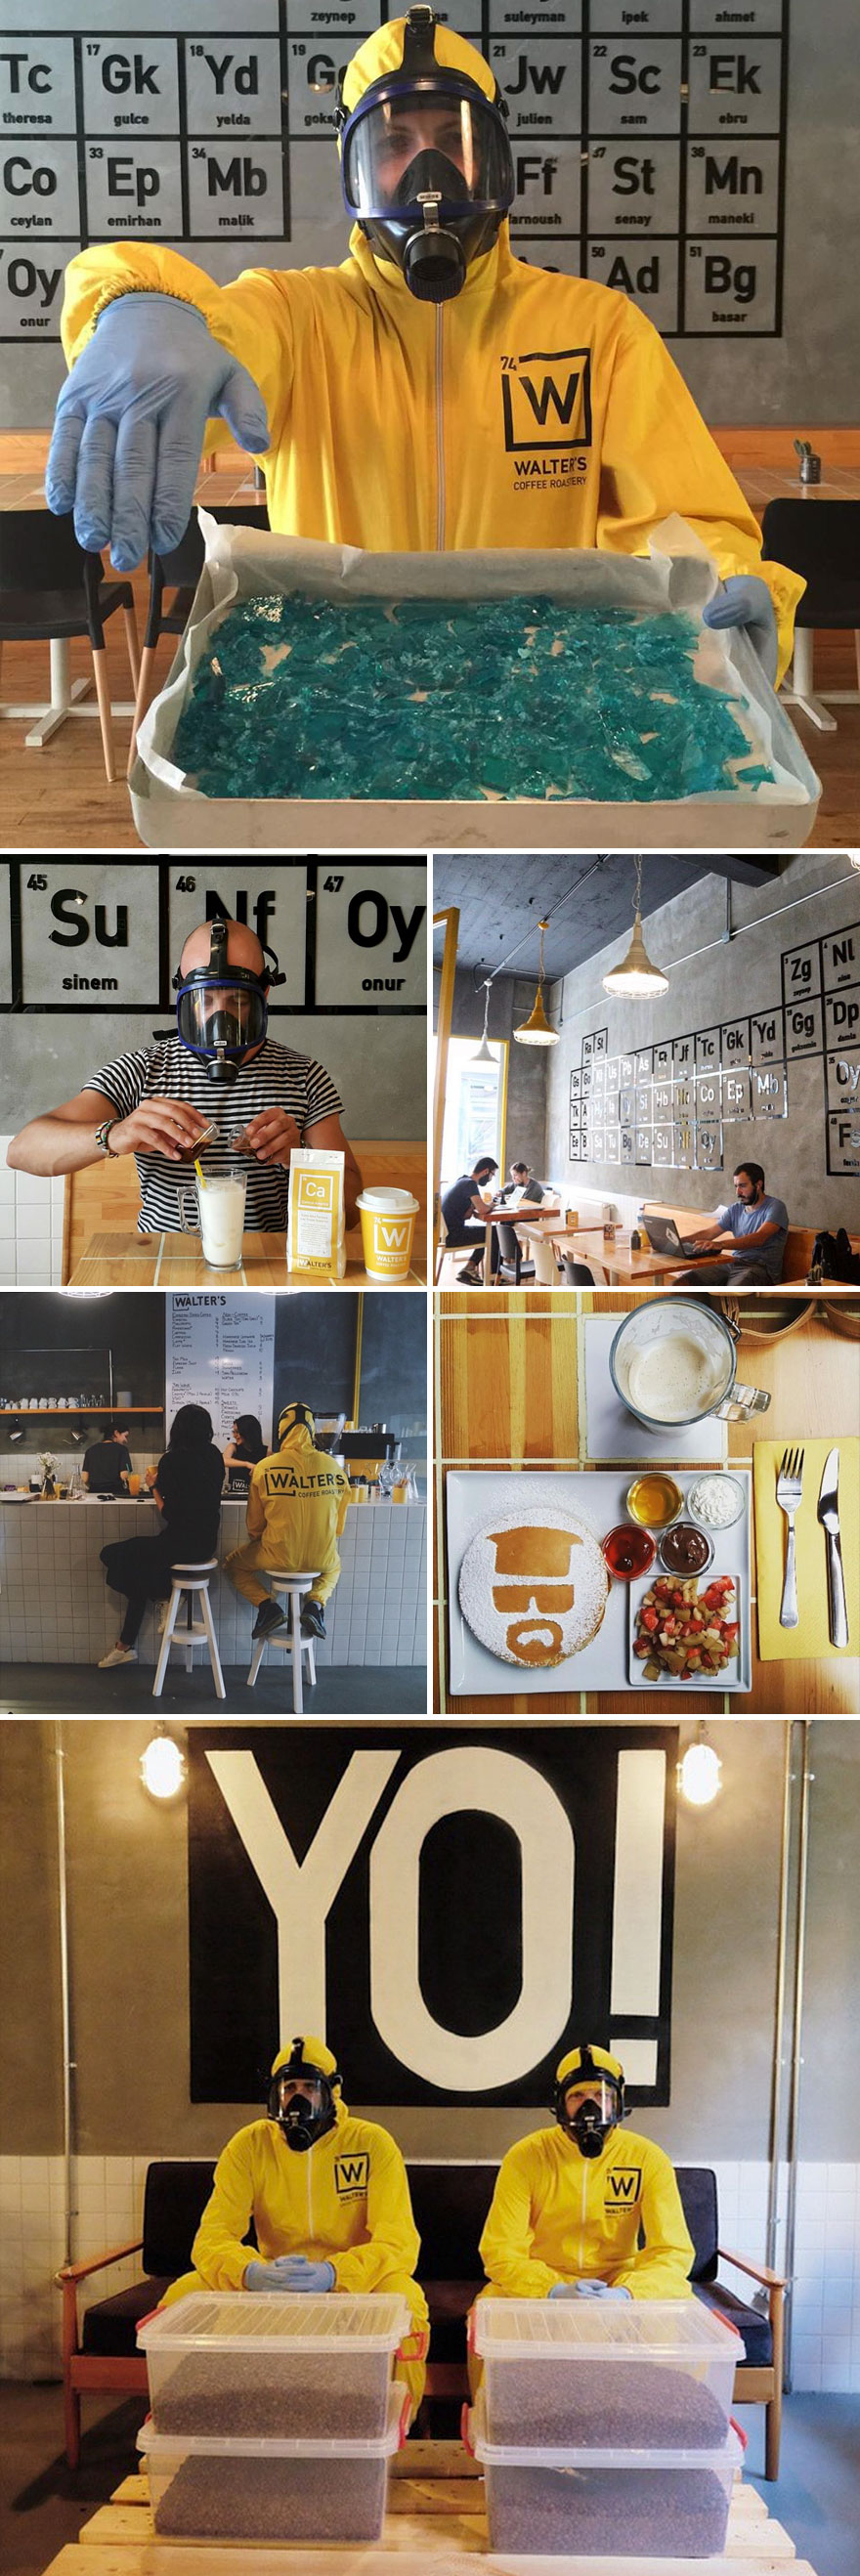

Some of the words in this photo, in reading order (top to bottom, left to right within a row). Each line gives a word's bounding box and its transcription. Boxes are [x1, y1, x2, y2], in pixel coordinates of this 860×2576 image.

[311, 12, 356, 23] zeynep
[504, 11, 565, 24] suleyman
[622, 11, 649, 24] ipek
[714, 11, 755, 22] ahmet
[86, 44, 100, 56] 17
[190, 45, 204, 57] 18
[292, 45, 306, 56] 19
[494, 46, 505, 57] 21
[593, 46, 607, 57] 22
[693, 46, 707, 57] 23
[0, 54, 53, 94] Tc
[102, 54, 161, 95] Gk
[204, 55, 259, 95] Yd
[504, 56, 567, 95] Jw
[609, 55, 662, 95] Sc
[710, 55, 761, 95] Ek
[3, 112, 52, 124] theresa
[113, 113, 150, 127] gulce
[216, 113, 250, 127] yelda
[516, 112, 552, 126] julien
[621, 114, 647, 125] sam
[718, 112, 748, 124] ebru
[89, 148, 104, 158] 33
[192, 148, 206, 159] 34
[592, 148, 606, 158] 37
[691, 148, 705, 158] 38
[3, 156, 57, 196] Co
[107, 157, 160, 206] Ep
[207, 157, 267, 196] Mb
[516, 156, 557, 195] Ff
[612, 156, 656, 195] St
[705, 156, 763, 195] Mn
[10, 215, 52, 229] ceylan
[108, 215, 161, 227] emirhan
[218, 215, 254, 227] malik
[615, 214, 652, 227] senay
[709, 213, 754, 225] maneki
[591, 246, 605, 257] 50
[689, 246, 702, 257] 51
[8, 258, 63, 308] Oy
[606, 256, 660, 294] Ad
[705, 256, 756, 304] Bg
[20, 318, 51, 327] onur
[711, 311, 748, 322] basar
[500, 356, 517, 371] 74
[518, 372, 580, 425] W
[514, 456, 587, 476] WALTER'S
[513, 480, 547, 491] COFFEE
[549, 476, 587, 490] ROASTERY
[26, 874, 48, 891] 45
[176, 875, 196, 893] 46
[323, 876, 344, 892] 47
[48, 888, 129, 948] Su
[347, 889, 427, 963] Oy
[791, 957, 812, 982] Zg
[63, 973, 118, 991] sinem
[362, 977, 406, 991] onur
[833, 1001, 860, 1028] Dp
[756, 1020, 775, 1043] Yd
[793, 1012, 815, 1038] Gg
[701, 1039, 714, 1056] Tc
[726, 1030, 744, 1051] Gk
[679, 1044, 689, 1062] Jf
[727, 1079, 744, 1103] Ep
[756, 1073, 779, 1095] Mb
[701, 1085, 714, 1102] Co
[656, 1132, 668, 1149] Su
[306, 1181, 325, 1198] Ca
[381, 1226, 407, 1247] W
[175, 1296, 227, 1308] WALTER'S
[204, 1746, 666, 2092] YO!
[340, 2161, 364, 2183] W
[611, 2175, 633, 2197] W
